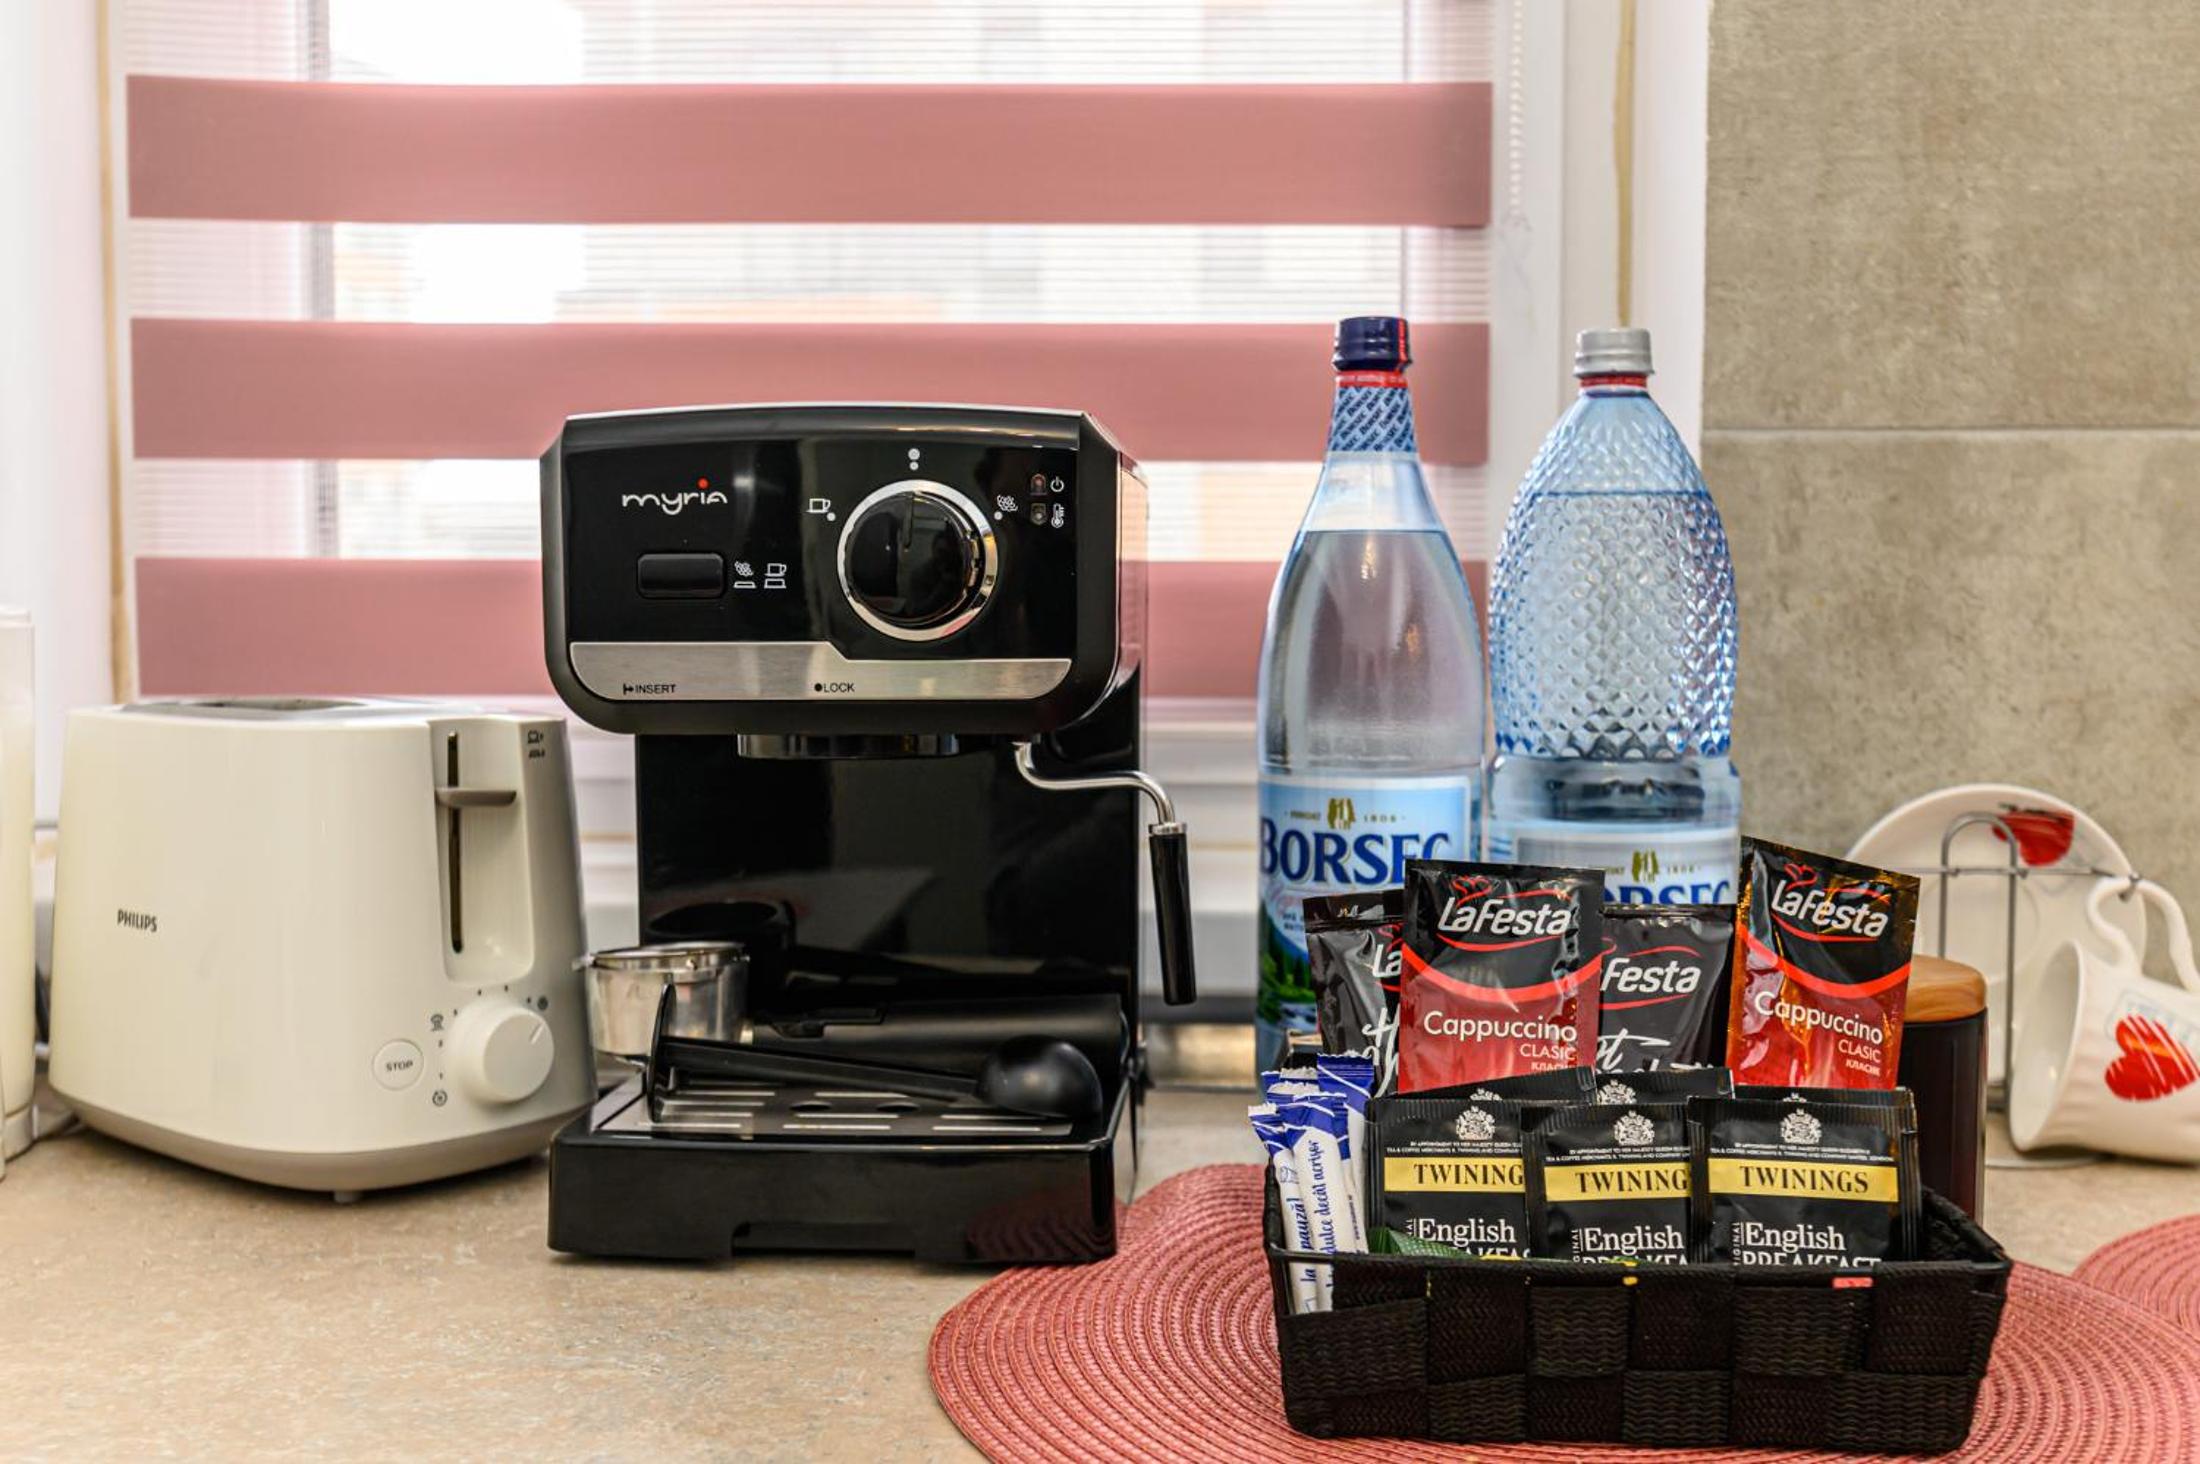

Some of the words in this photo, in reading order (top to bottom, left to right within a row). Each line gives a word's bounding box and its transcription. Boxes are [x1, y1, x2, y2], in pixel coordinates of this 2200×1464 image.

[622, 476, 728, 515] myria
[635, 683, 677, 694] INSERT
[823, 682, 855, 693] LOCK
[117, 908, 158, 933] PHILIPS
[1424, 1010, 1578, 1042] Cappuccino
[1755, 991, 1884, 1046] Cappuccino
[1519, 1043, 1577, 1061] CLASIC
[1838, 1038, 1883, 1065] CLASIC
[386, 1060, 413, 1073] STOP
[1413, 1163, 1523, 1186] TWINING
[1575, 1168, 1688, 1193] TWINING
[1740, 1165, 1869, 1194] TWININGS
[1418, 1217, 1517, 1247] English
[1584, 1224, 1685, 1256] English
[1745, 1221, 1846, 1254] English
[1300, 1267, 1317, 1282] la
